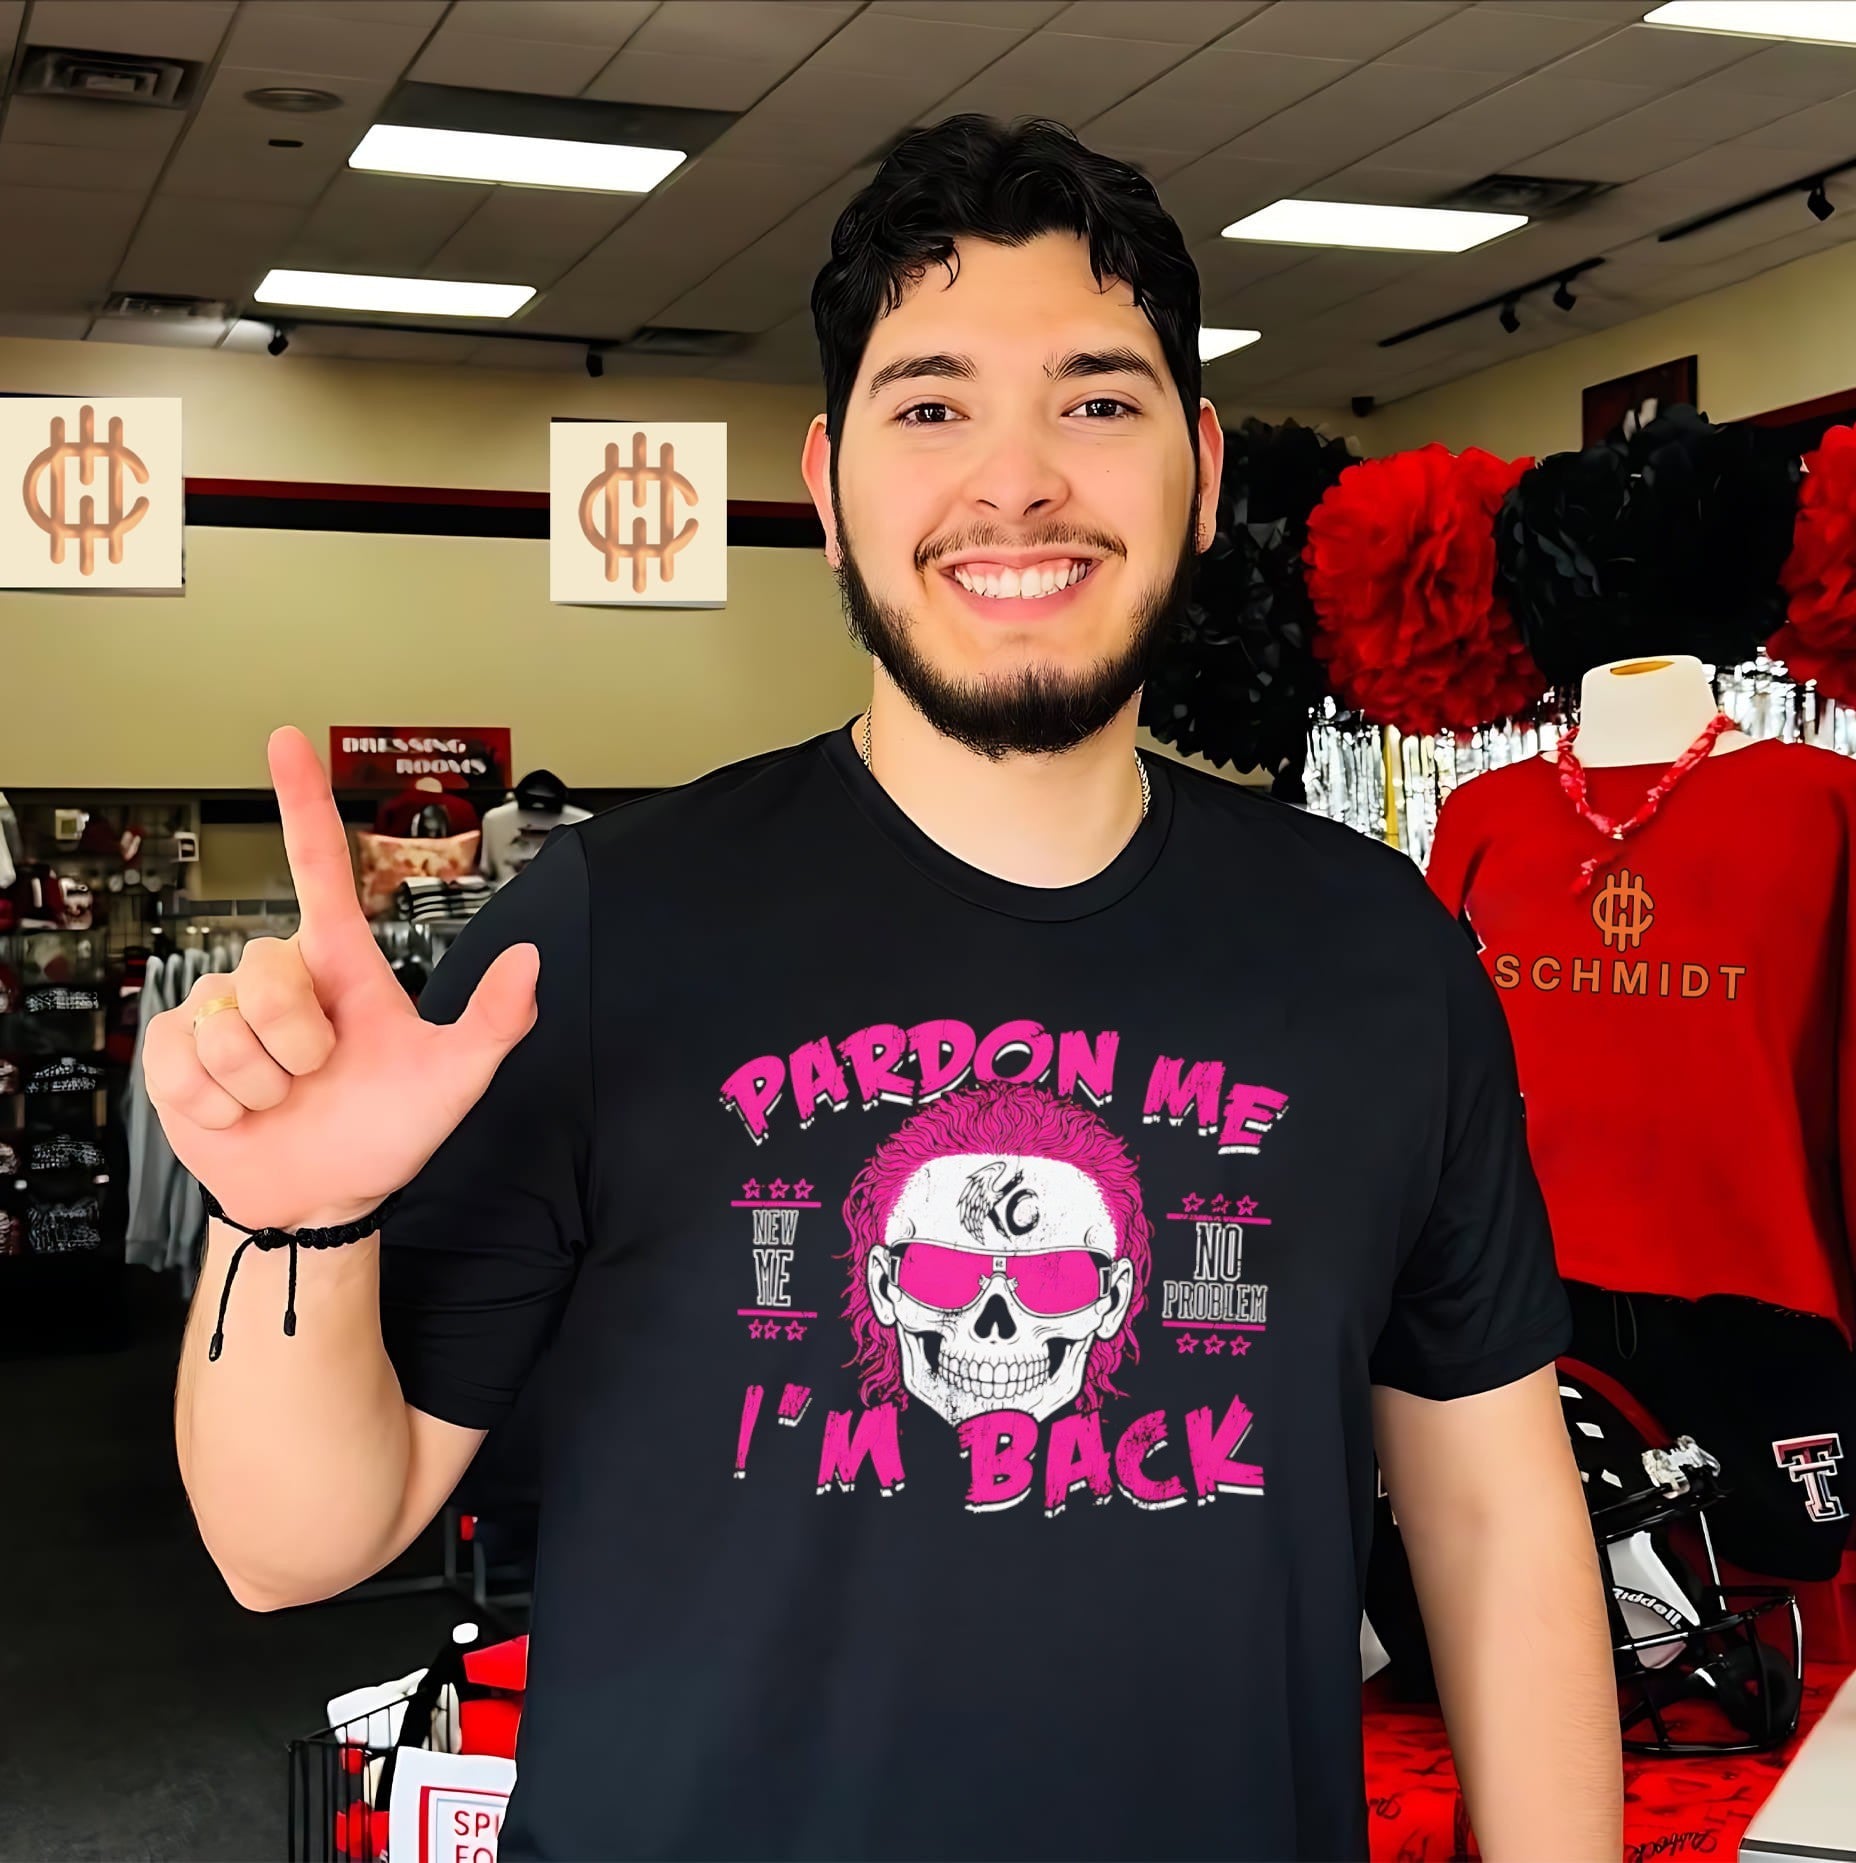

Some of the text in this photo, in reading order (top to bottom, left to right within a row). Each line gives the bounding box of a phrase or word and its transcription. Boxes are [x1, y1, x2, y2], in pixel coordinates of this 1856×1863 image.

[342, 737, 467, 754] DRESSING
[396, 758, 487, 775] ROOMS
[1494, 953, 1747, 1001] SCHMIDT
[719, 1019, 1290, 1155] PARDON ME
[752, 1209, 799, 1245] NEW
[1193, 1221, 1243, 1282] NO
[752, 1248, 794, 1307] ME
[1162, 1280, 1268, 1323] PROBLEM
[733, 1382, 1266, 1518] I'M BACK
